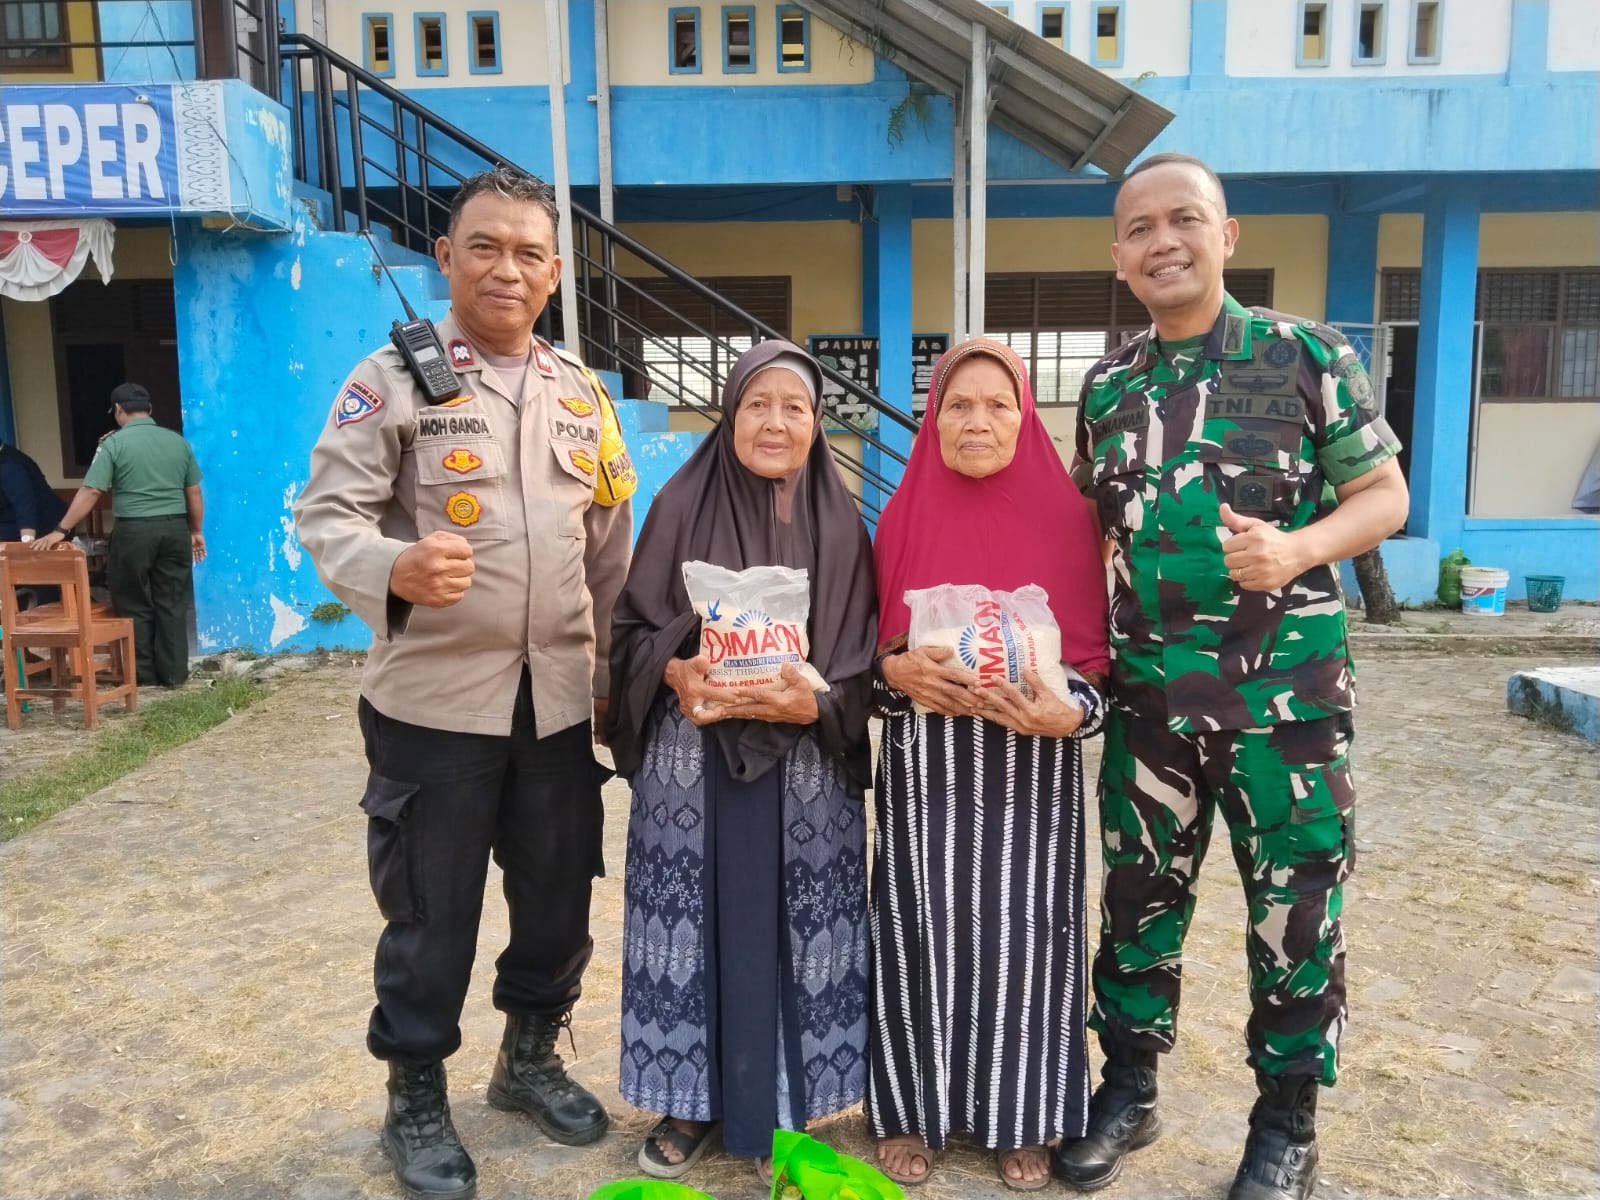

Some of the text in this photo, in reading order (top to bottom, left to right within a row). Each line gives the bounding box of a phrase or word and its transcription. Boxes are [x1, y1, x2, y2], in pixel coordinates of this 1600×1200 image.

[0, 103, 166, 201] EPER
[1209, 398, 1299, 418] TNI AD
[420, 417, 490, 437] MOH GANDA
[555, 420, 598, 445] POLRI
[702, 623, 806, 664] DIMAN
